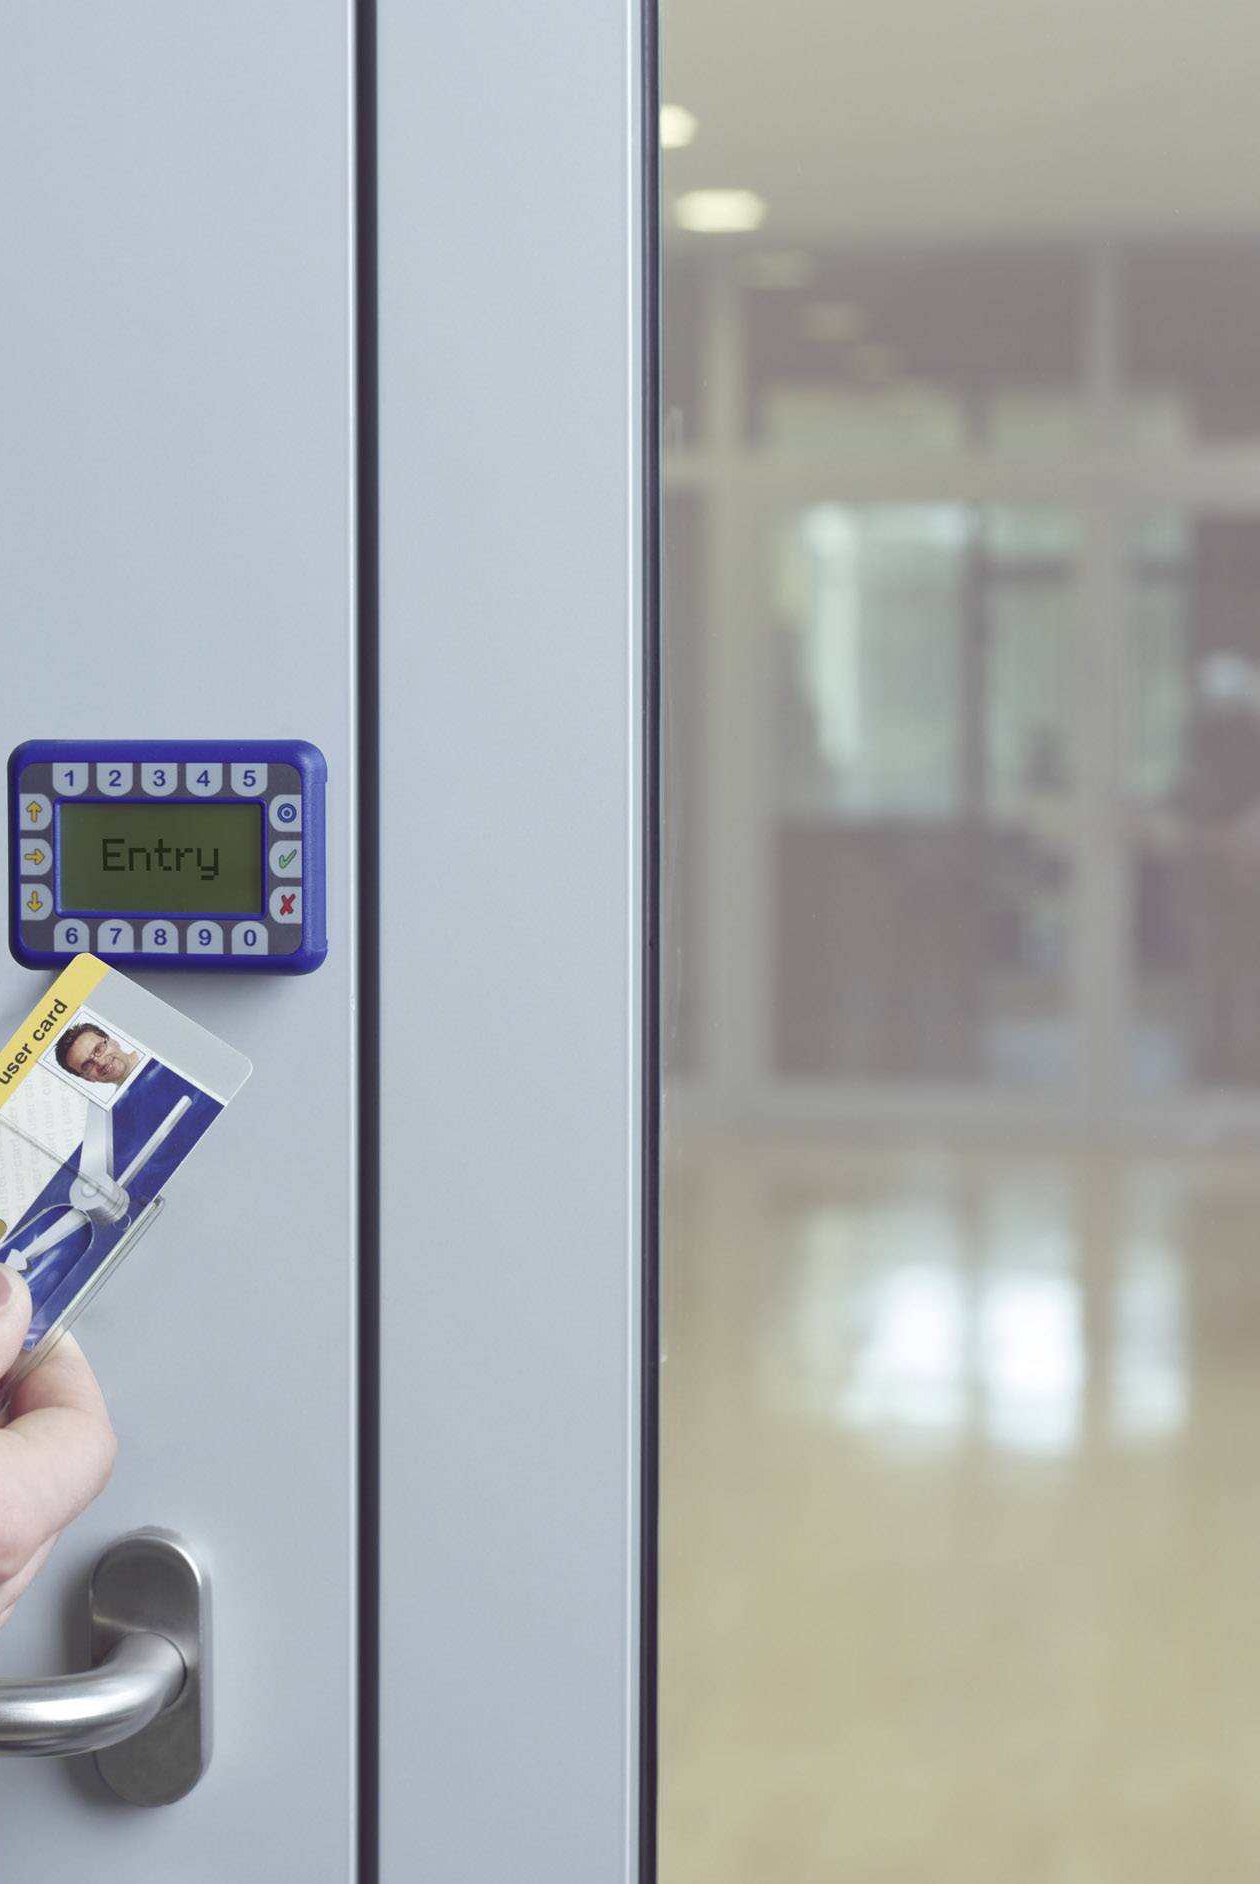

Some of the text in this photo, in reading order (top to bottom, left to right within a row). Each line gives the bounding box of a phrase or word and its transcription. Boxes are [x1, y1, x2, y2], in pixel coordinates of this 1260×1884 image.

[64, 770, 256, 787] 1 2 3 4 5
[101, 838, 219, 881] Entry
[65, 927, 257, 946] 6 7 8 9 0
[32, 998, 68, 1042] card
